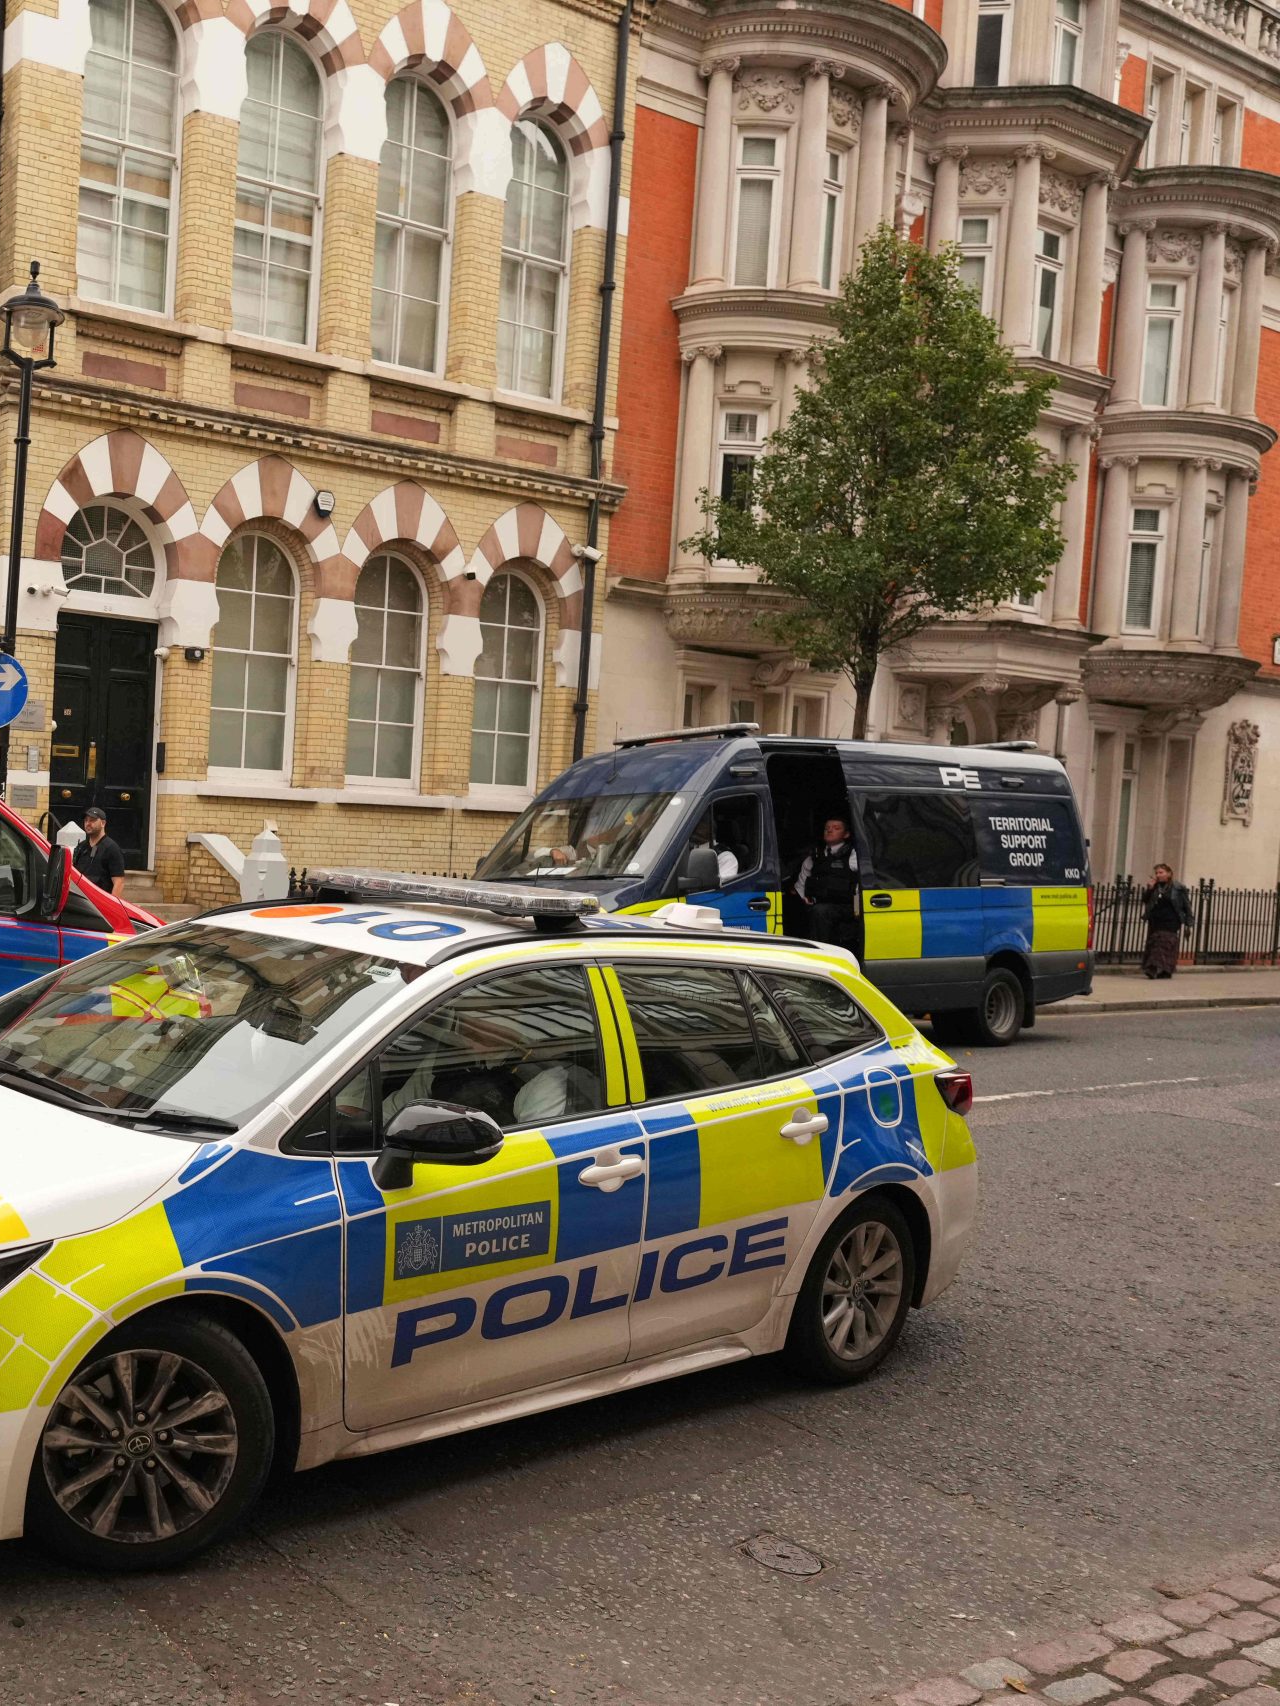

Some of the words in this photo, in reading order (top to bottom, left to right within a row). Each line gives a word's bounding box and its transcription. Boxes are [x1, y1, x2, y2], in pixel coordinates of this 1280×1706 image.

[938, 767, 982, 789] PE
[989, 816, 1054, 832] TERRITORIAL
[1001, 834, 1047, 849] SUPPORT
[1009, 853, 1044, 867] GROUP
[1064, 868, 1080, 879] KKQ
[452, 1211, 543, 1238] METROPOLITAN
[465, 1233, 531, 1258] POLICE
[391, 1216, 789, 1369] POLICE
